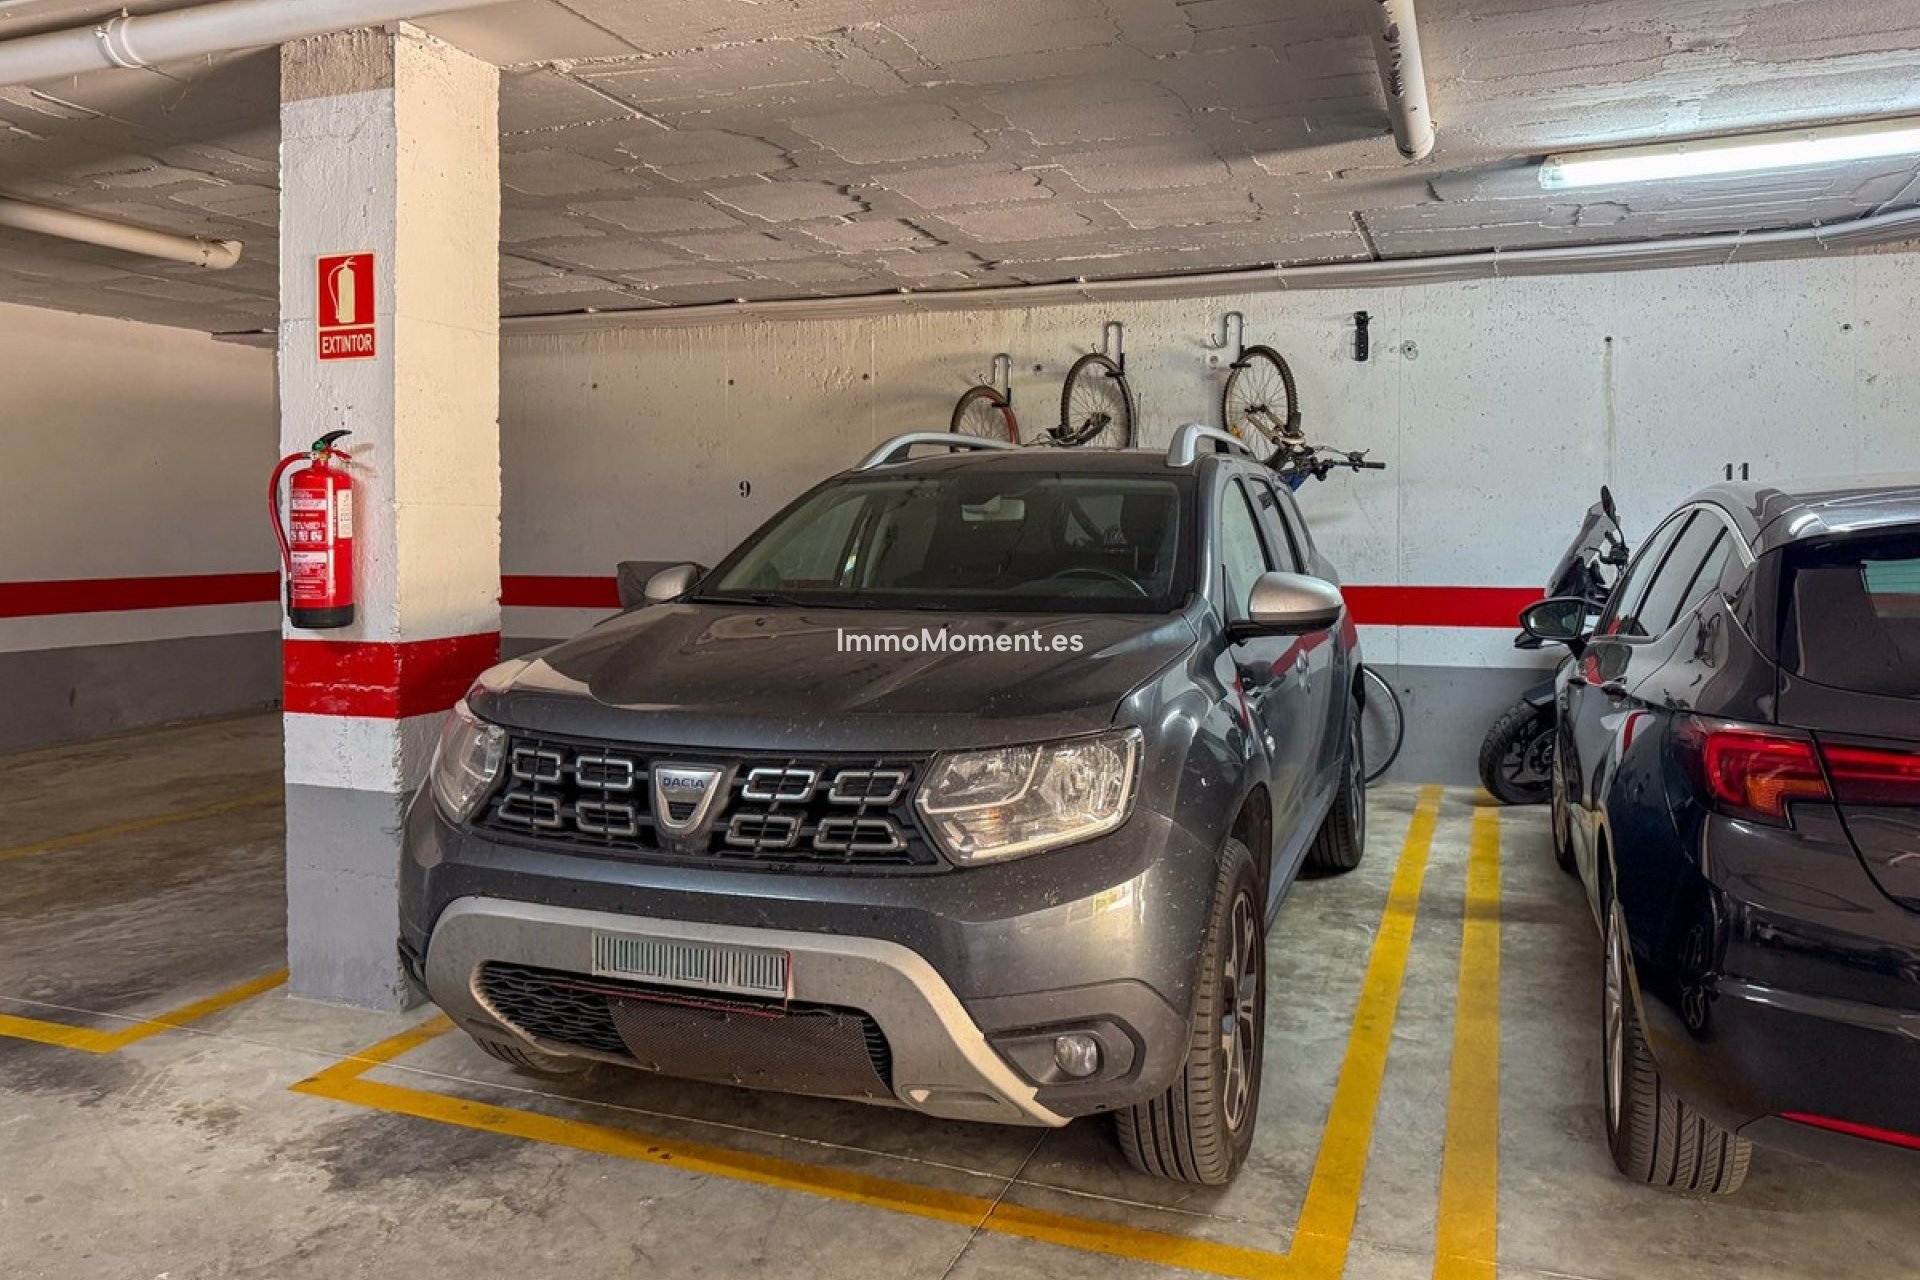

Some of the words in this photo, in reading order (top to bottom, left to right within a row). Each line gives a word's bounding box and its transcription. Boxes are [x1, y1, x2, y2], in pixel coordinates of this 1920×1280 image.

[322, 333, 373, 354] EXTINTOR
[1722, 462, 1749, 481] 11
[739, 480, 751, 498] 9
[663, 777, 705, 789] DACIA
